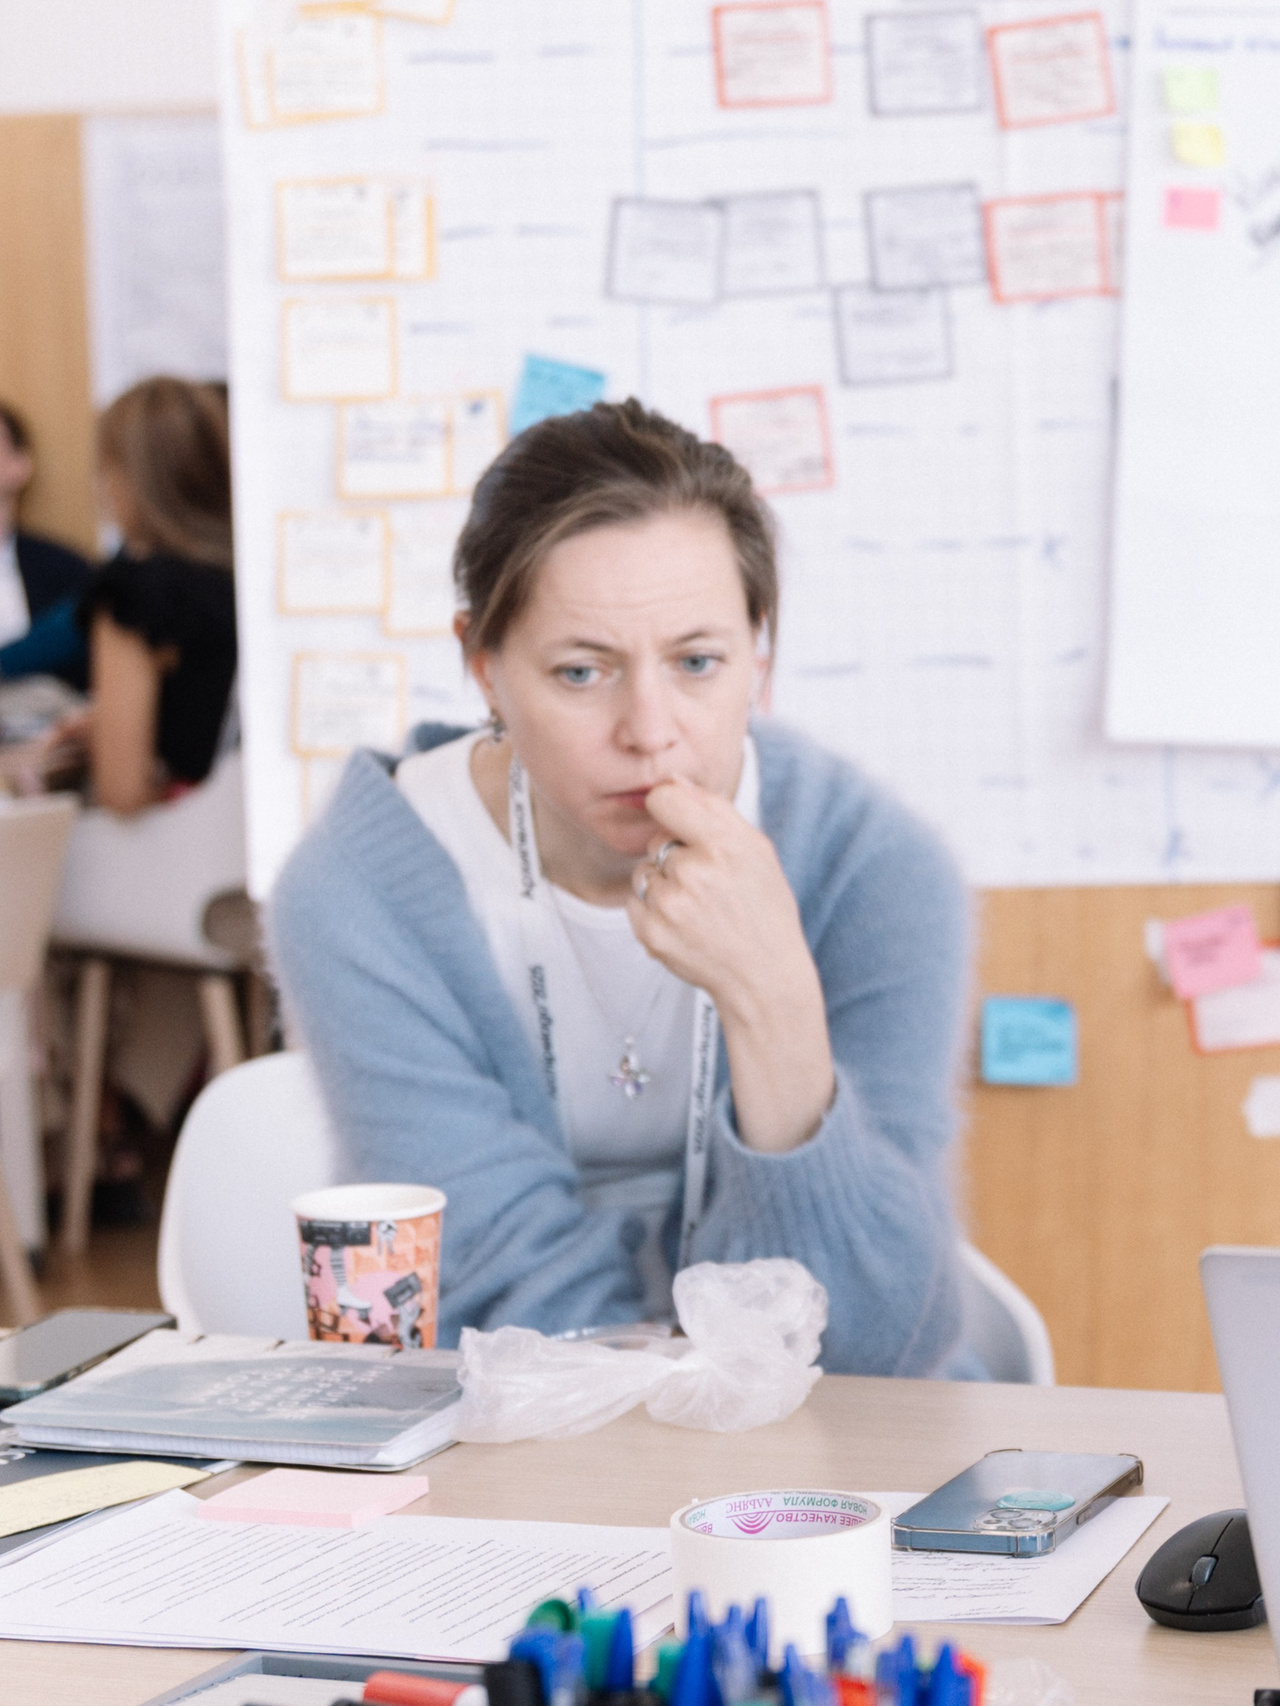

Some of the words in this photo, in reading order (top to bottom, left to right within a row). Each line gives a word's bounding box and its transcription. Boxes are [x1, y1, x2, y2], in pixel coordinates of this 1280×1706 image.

[726, 1497, 773, 1514] АЛЬЯНС
[783, 1496, 838, 1507] ФОРМУЛА
[840, 1498, 868, 1514] НОВАЯ
[776, 1512, 837, 1524] КАЧЕСТВО
